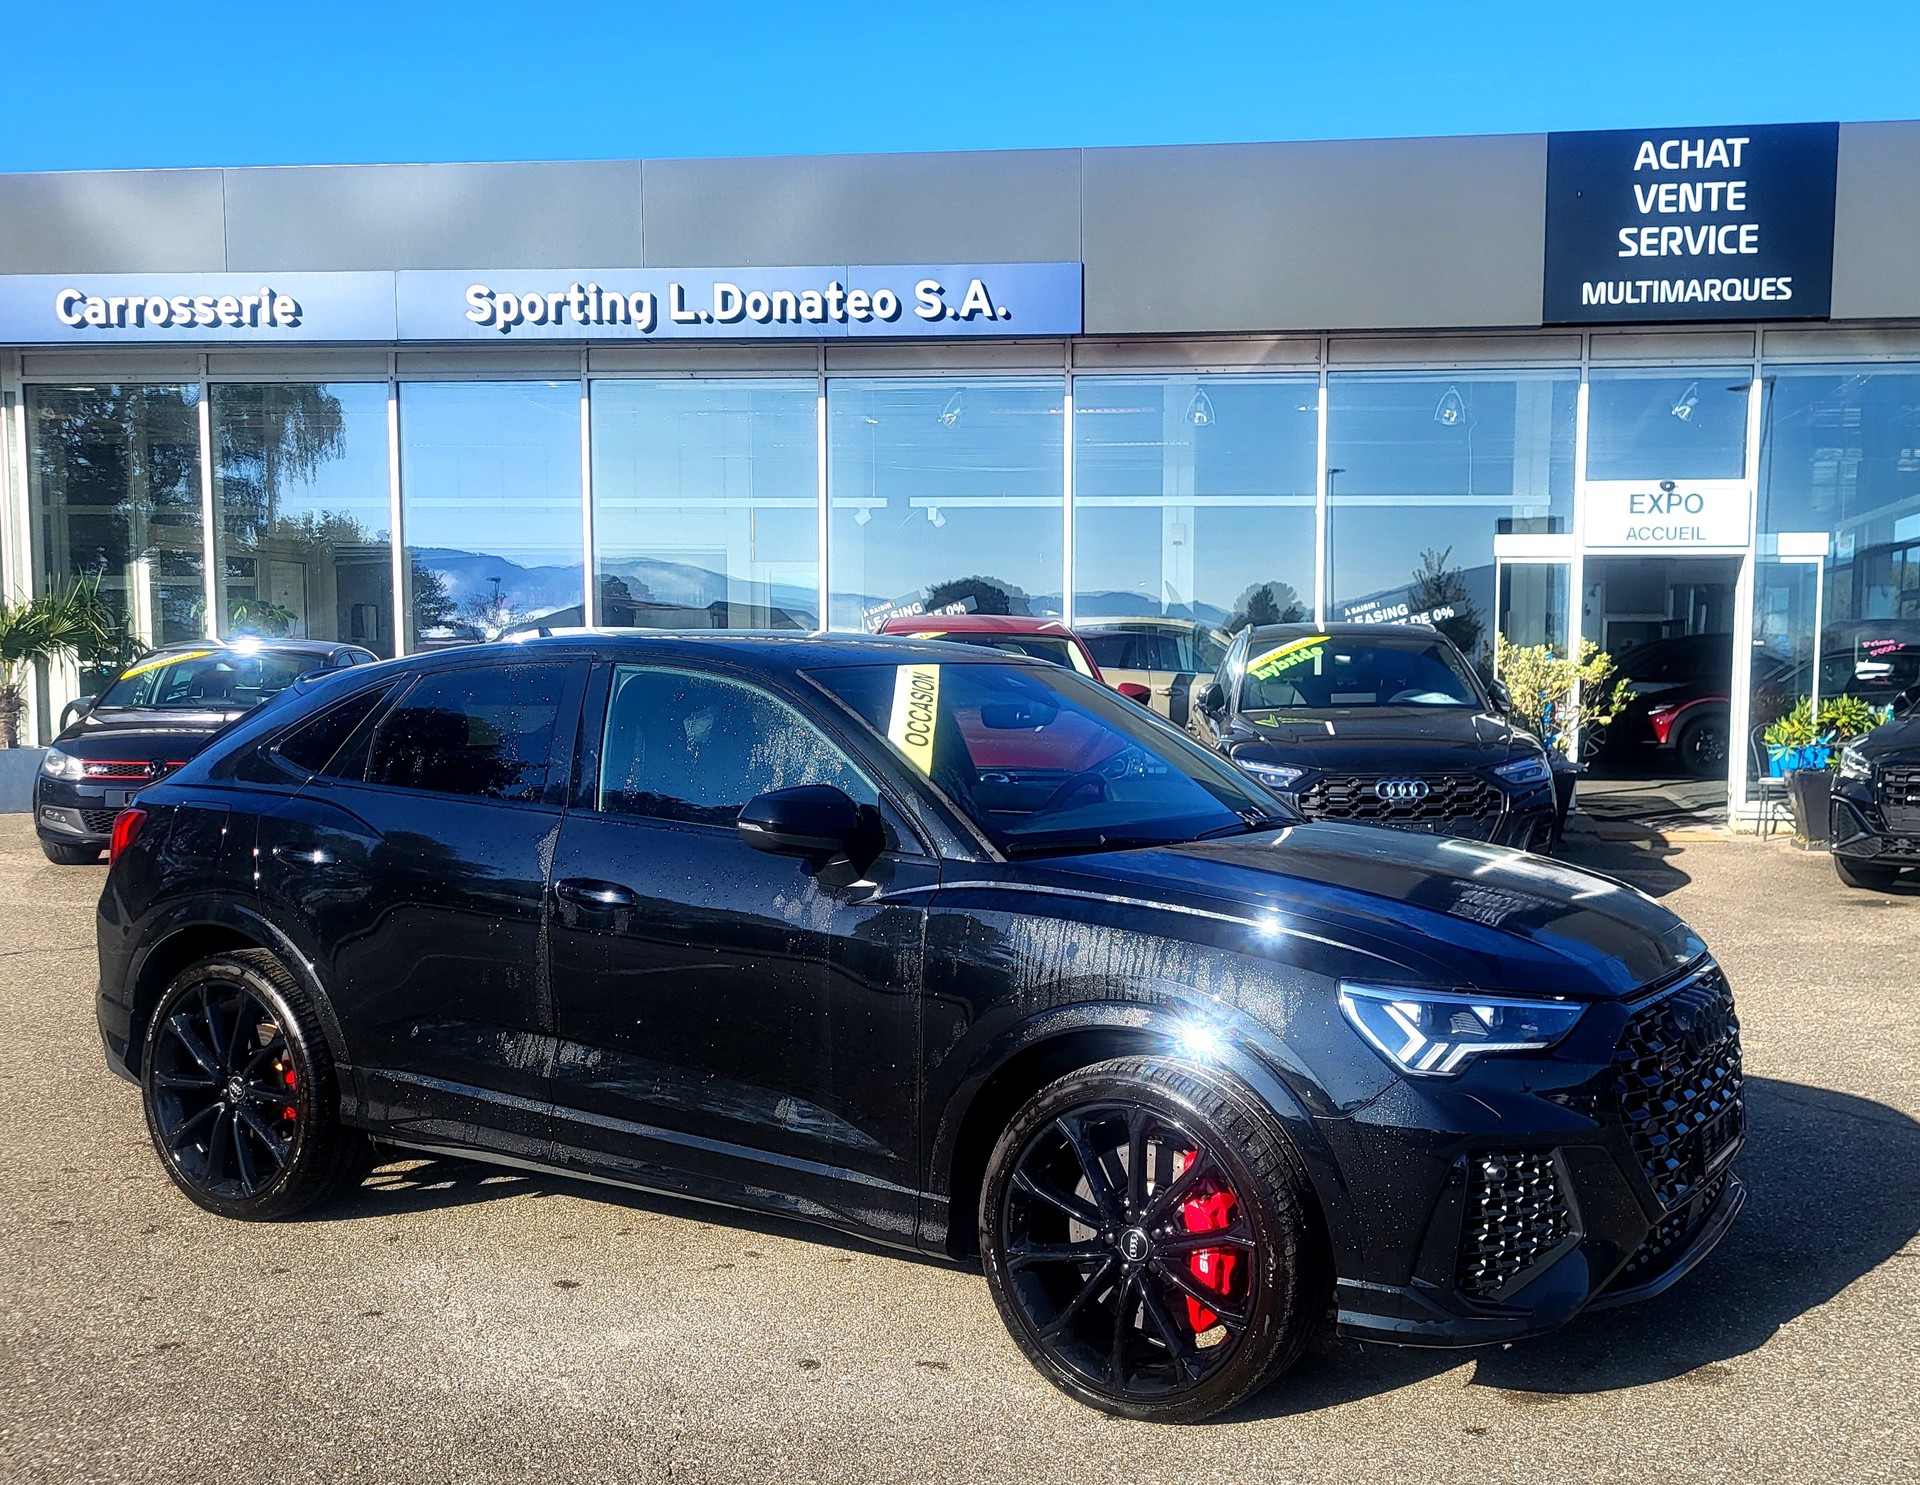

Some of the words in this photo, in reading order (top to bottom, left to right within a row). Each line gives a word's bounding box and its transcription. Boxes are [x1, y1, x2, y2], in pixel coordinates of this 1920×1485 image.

[1633, 137, 1750, 171] ACHAT
[1633, 181, 1747, 214] VENTE
[1618, 224, 1759, 257] SERVICE
[56, 286, 301, 327] Carrosserie
[464, 282, 655, 333] Sporting
[669, 280, 901, 322] L.Donateo
[913, 278, 1010, 321] S.A.
[1582, 277, 1792, 305] MULTIMARQUES
[1629, 493, 1704, 514] EXPO
[1626, 526, 1706, 541] ACCUEIL
[1350, 602, 1376, 615] SAISIR
[1433, 606, 1454, 622] 0%
[904, 670, 936, 747] OCCASION
